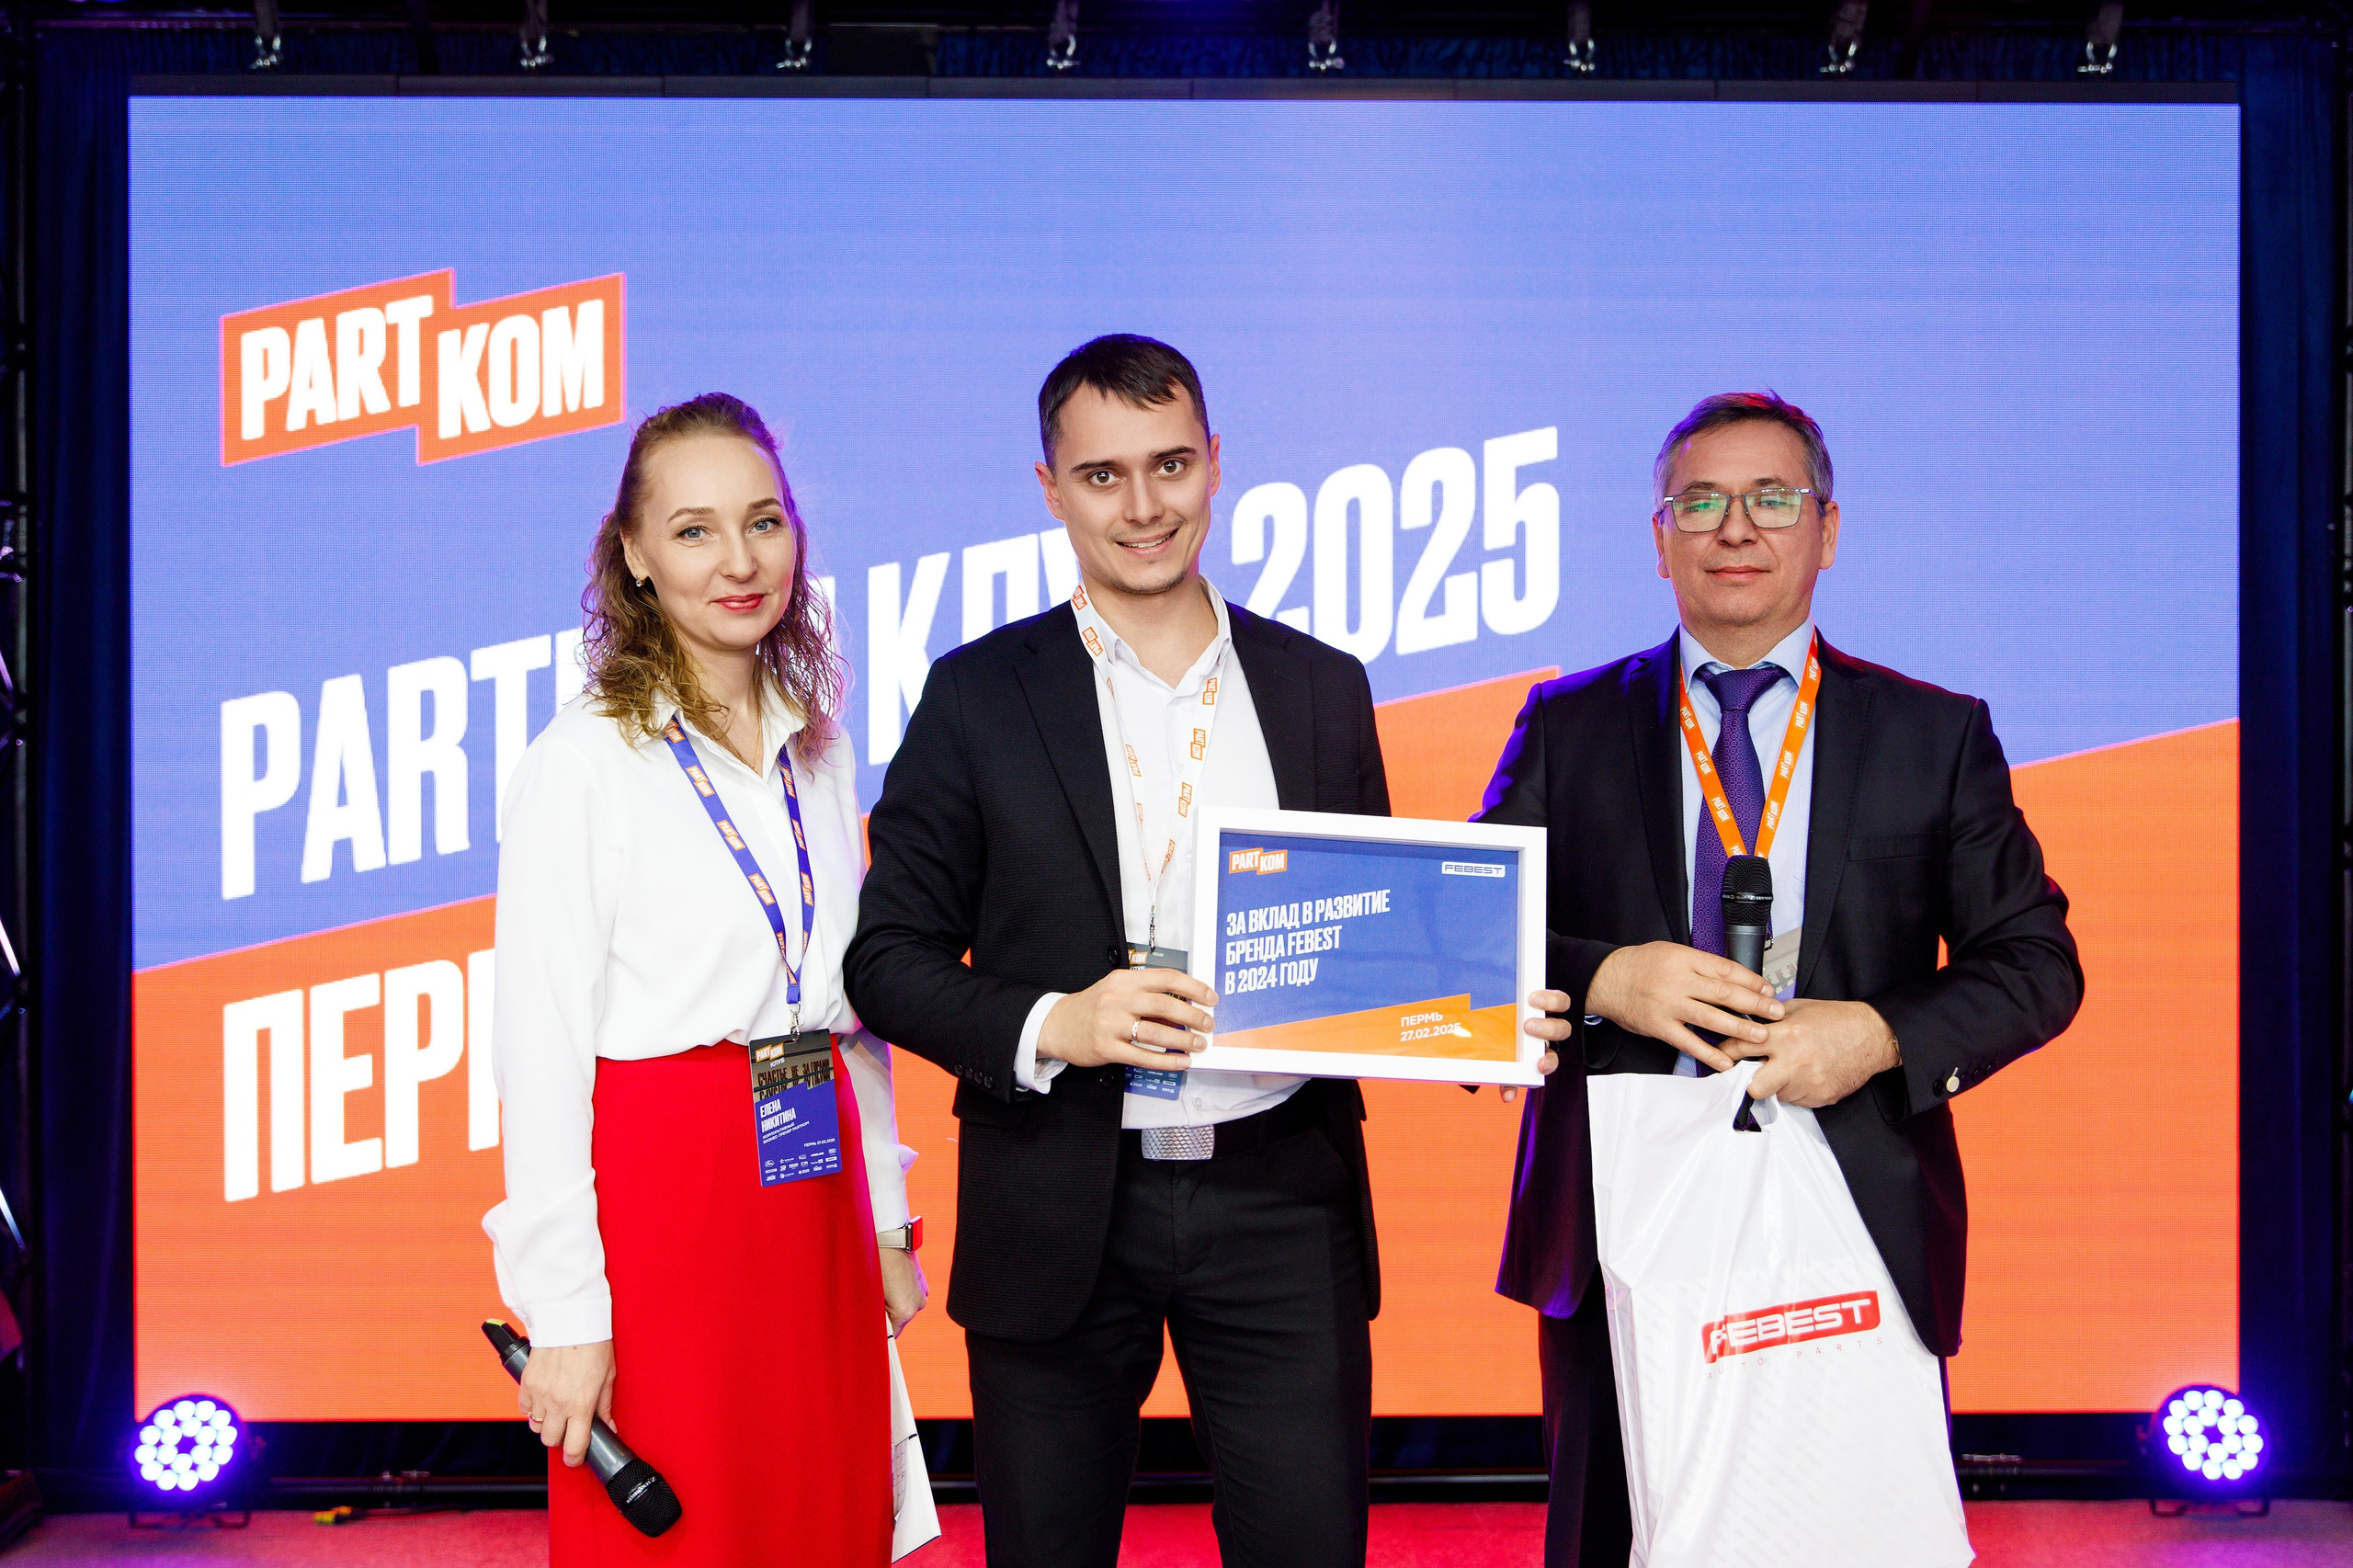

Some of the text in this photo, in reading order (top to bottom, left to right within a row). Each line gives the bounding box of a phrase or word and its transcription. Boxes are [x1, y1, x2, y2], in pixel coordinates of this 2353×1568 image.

[241, 295, 604, 440] PART KOM
[1232, 426, 1560, 665] 2025
[1232, 849, 1284, 872] PART KOM
[1444, 864, 1503, 875] FEBEST
[1226, 889, 1391, 937] ЗА ВКЛАД В РАЗВИТИЕ
[1225, 926, 1342, 966] БРЕНДА FEBEST
[1225, 958, 1319, 995] В 2024 ГОДУ
[1401, 1012, 1444, 1028] ПЕРМЬ
[223, 948, 501, 1201] ПЕР
[757, 1067, 788, 1086] СЧАСТЬЕ
[760, 1098, 781, 1118] ЕЛЕНА
[761, 1108, 796, 1132] НИКИТИНА
[1710, 1299, 1870, 1355] FEBEST
[1707, 1336, 1882, 1380] AUTO PARTS
